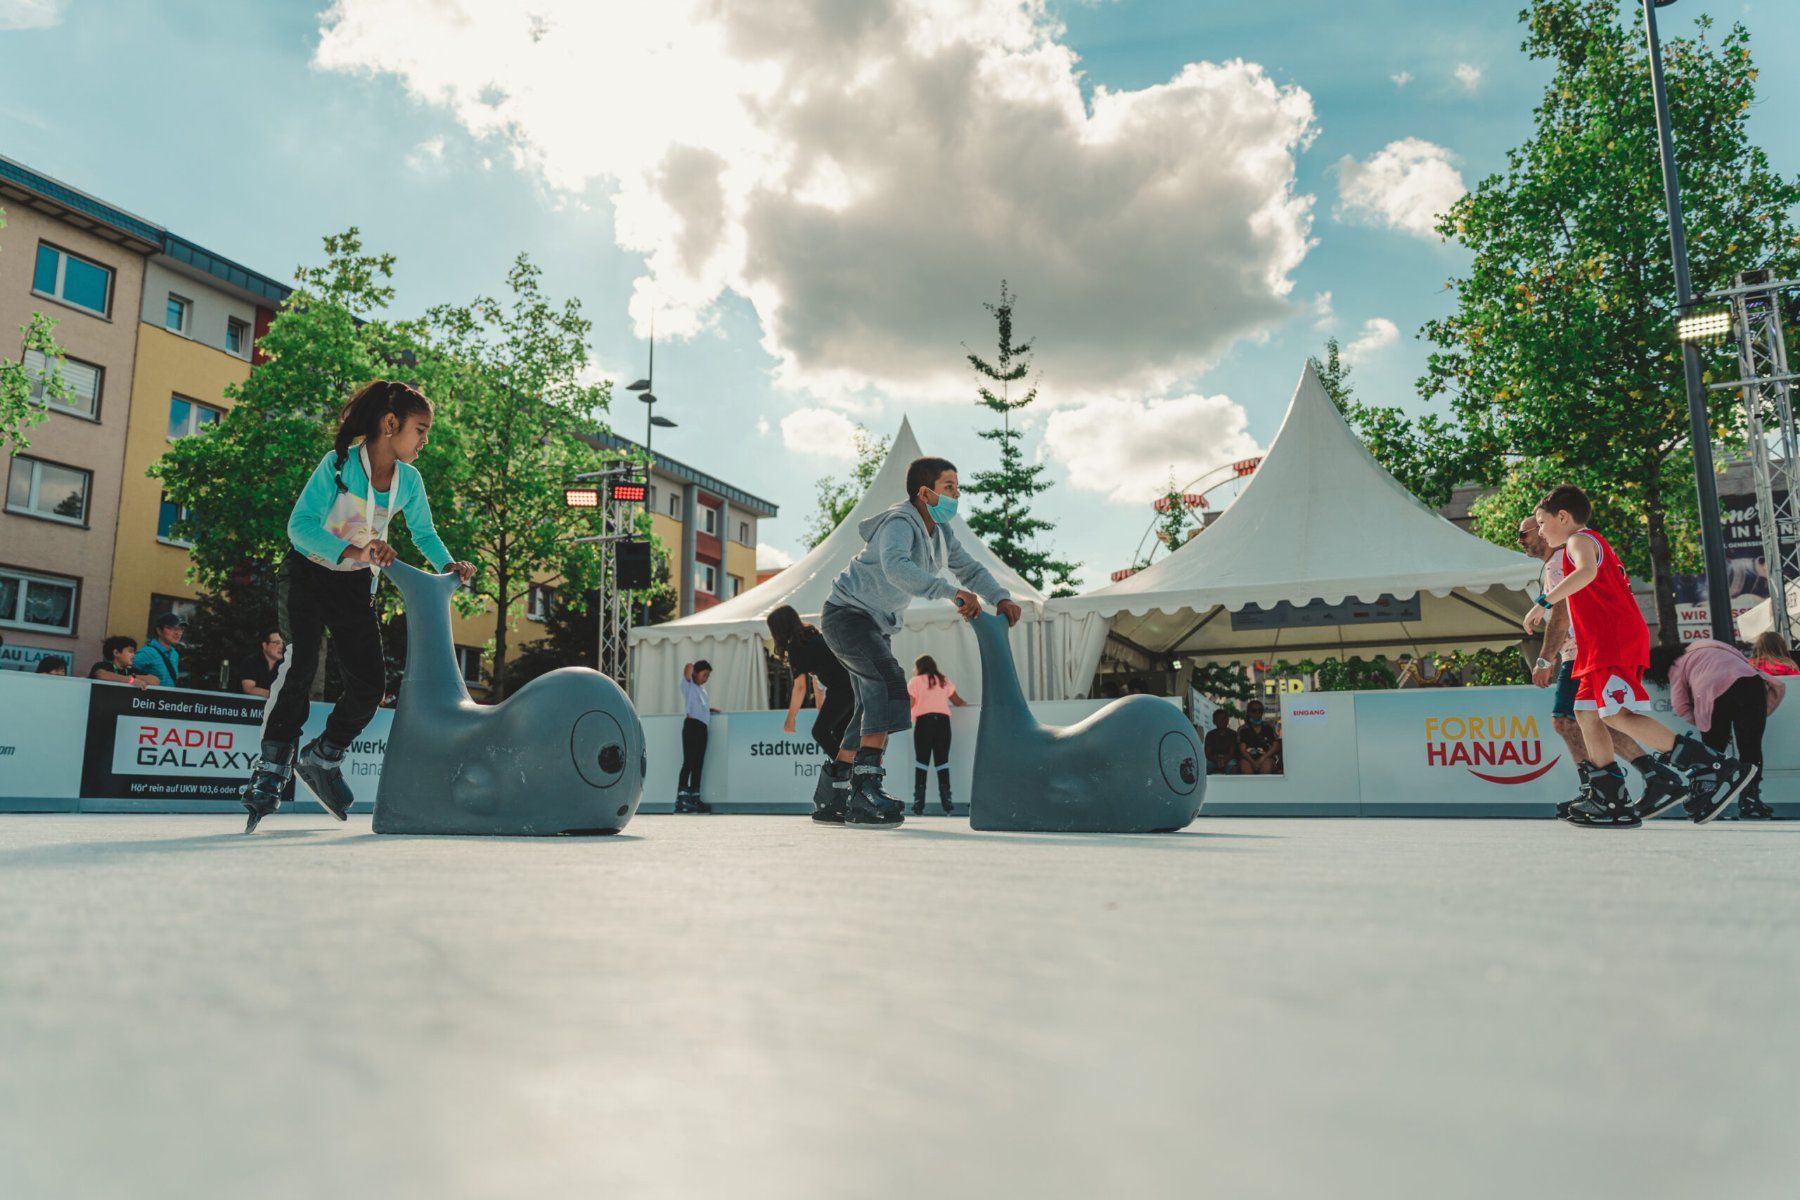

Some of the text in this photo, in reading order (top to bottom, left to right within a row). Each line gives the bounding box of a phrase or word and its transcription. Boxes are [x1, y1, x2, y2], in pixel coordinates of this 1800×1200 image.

[1731, 525, 1751, 539] IN
[1681, 610, 1708, 621] WIR
[1683, 628, 1711, 640] DAS
[132, 697, 155, 710] Dein
[158, 700, 192, 713] Sender
[194, 702, 208, 715] für
[209, 704, 239, 717] Hanau
[240, 709, 249, 718] &
[1293, 709, 1326, 717] EINGANG
[1424, 715, 1540, 741] FORUM
[138, 726, 234, 750] RADIO
[750, 740, 827, 756] stadtwer
[1426, 740, 1542, 767] HANAU
[136, 747, 259, 770] GALAXY
[148, 784, 164, 793] rein
[165, 784, 179, 794] auf
[180, 784, 198, 794] UKW
[219, 785, 236, 795] oder
